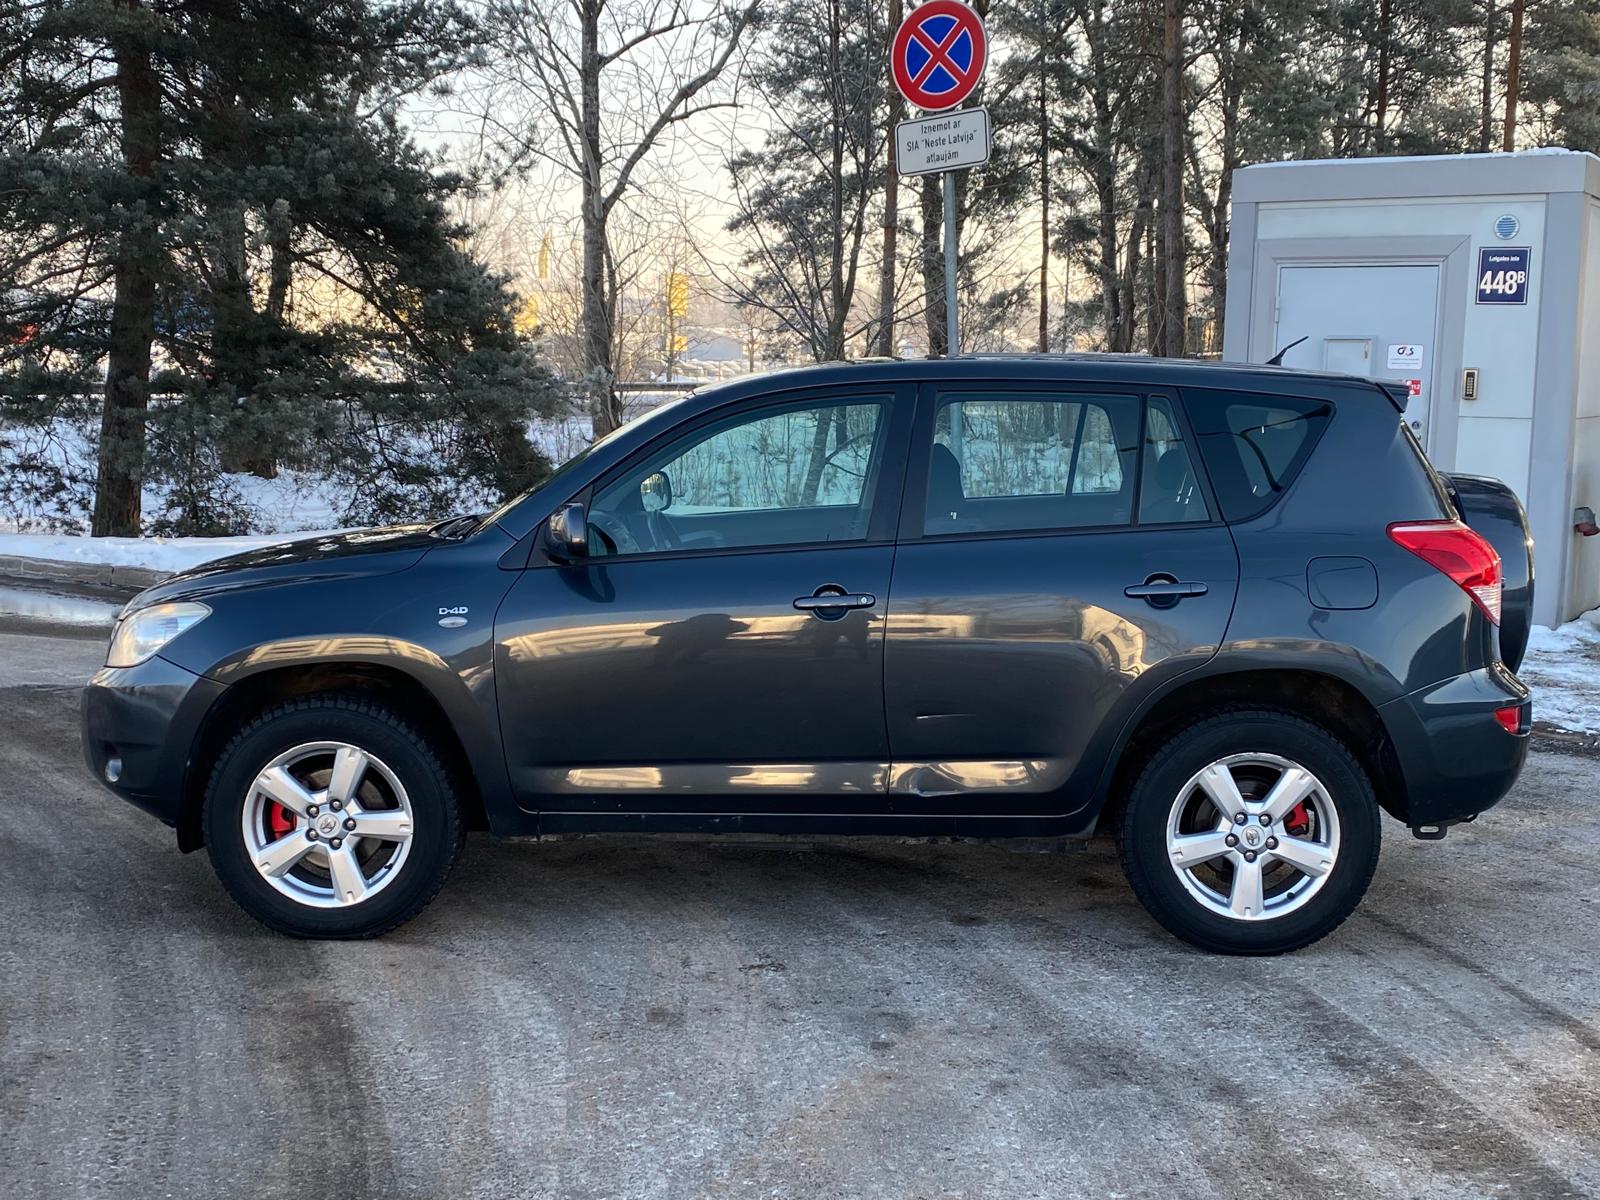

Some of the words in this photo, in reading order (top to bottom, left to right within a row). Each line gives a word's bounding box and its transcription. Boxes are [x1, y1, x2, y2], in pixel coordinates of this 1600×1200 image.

[953, 120, 961, 128] ar
[906, 141, 920, 152] SIA
[439, 606, 469, 615] D-4D
